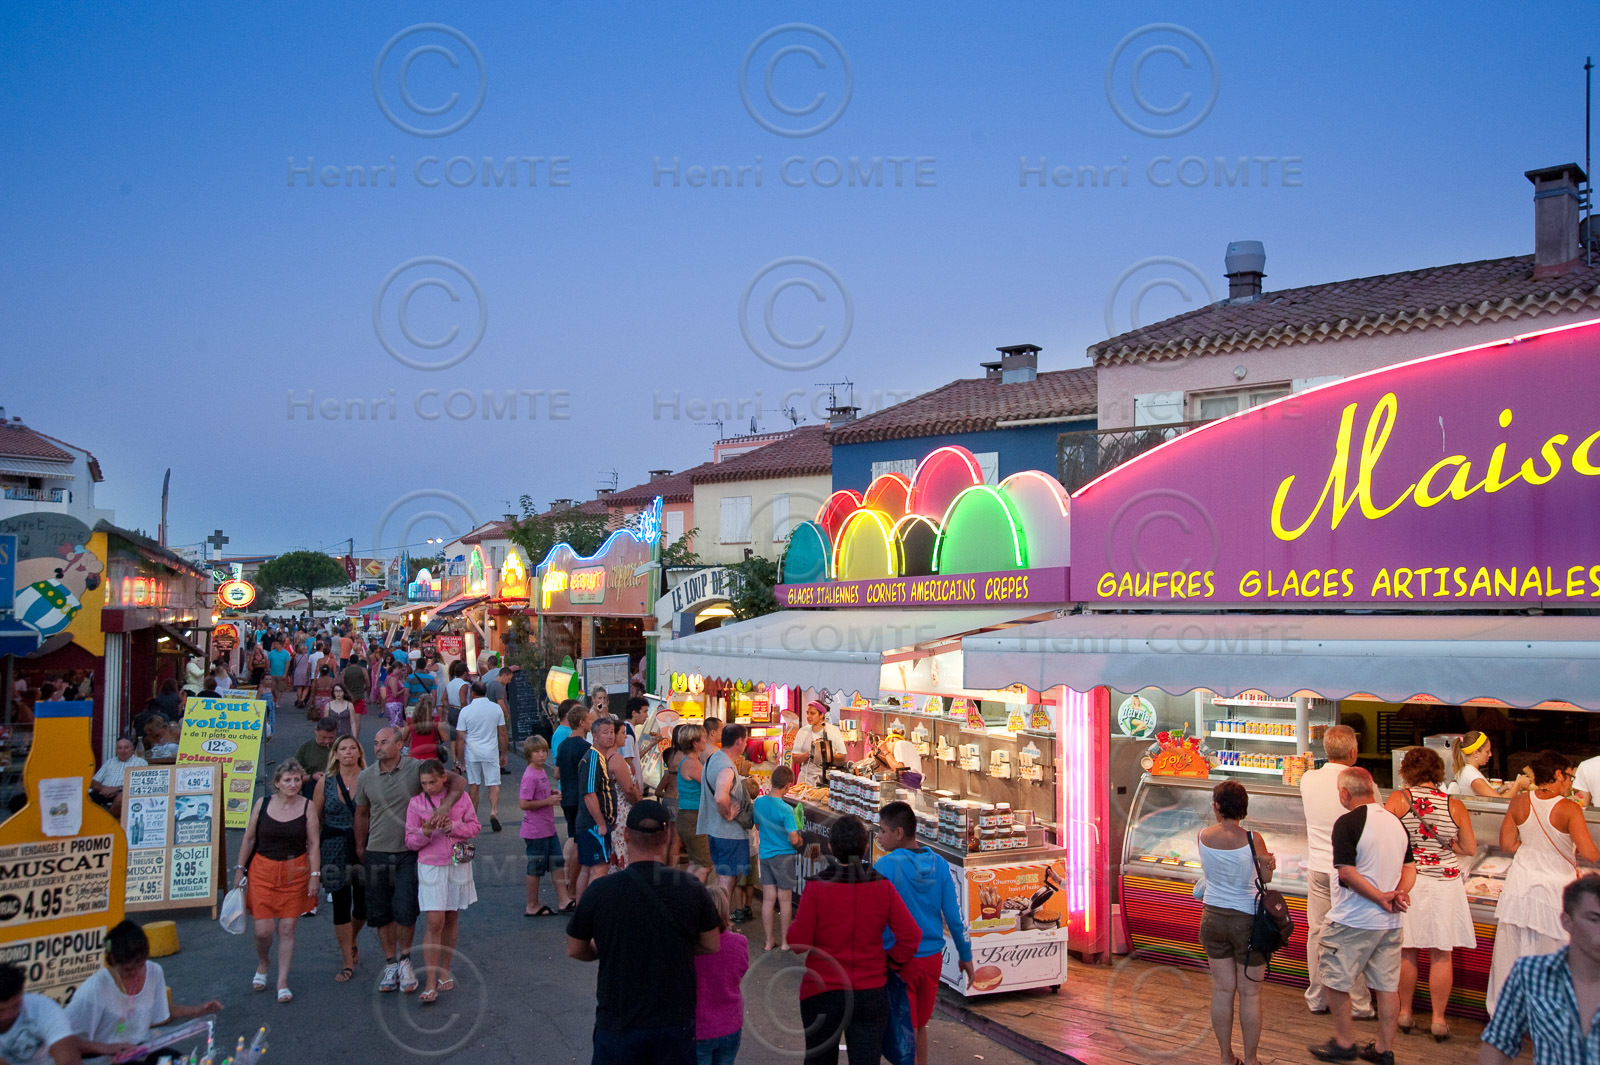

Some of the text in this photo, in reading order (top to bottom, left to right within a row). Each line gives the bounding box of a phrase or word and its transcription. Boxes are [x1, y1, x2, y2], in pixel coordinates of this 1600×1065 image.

[1096, 565, 1600, 599] GAUFRES GLACES ARTISANALES
[671, 586, 684, 612] LE
[684, 573, 707, 604] LOUP
[711, 570, 725, 596] DE
[787, 575, 1029, 605] GLACES ITALIENNES CORNETS AMERICAINS CREPES
[201, 699, 250, 711] Tout
[219, 711, 227, 719] à
[185, 717, 261, 730] volonté
[209, 731, 226, 739] plats
[178, 753, 233, 763] Poissons
[131, 770, 159, 778] FAUGERES
[188, 778, 201, 787] 4.90
[70, 837, 111, 854] PROMO
[173, 846, 209, 861] Soleil
[0, 852, 110, 879] MUSCAT
[133, 858, 155, 866] TIREUSE
[175, 861, 197, 877] 3.95
[128, 865, 164, 876] MUSCAT
[33, 875, 66, 889] RESERVE
[139, 881, 157, 895] 4.95
[173, 877, 208, 886] MUSCAT
[23, 890, 63, 919] 4.95
[34, 929, 103, 960] PICPOUL
[60, 951, 102, 967] PINET
[977, 942, 1058, 967] Beignets
[58, 963, 101, 978] Bouteille
